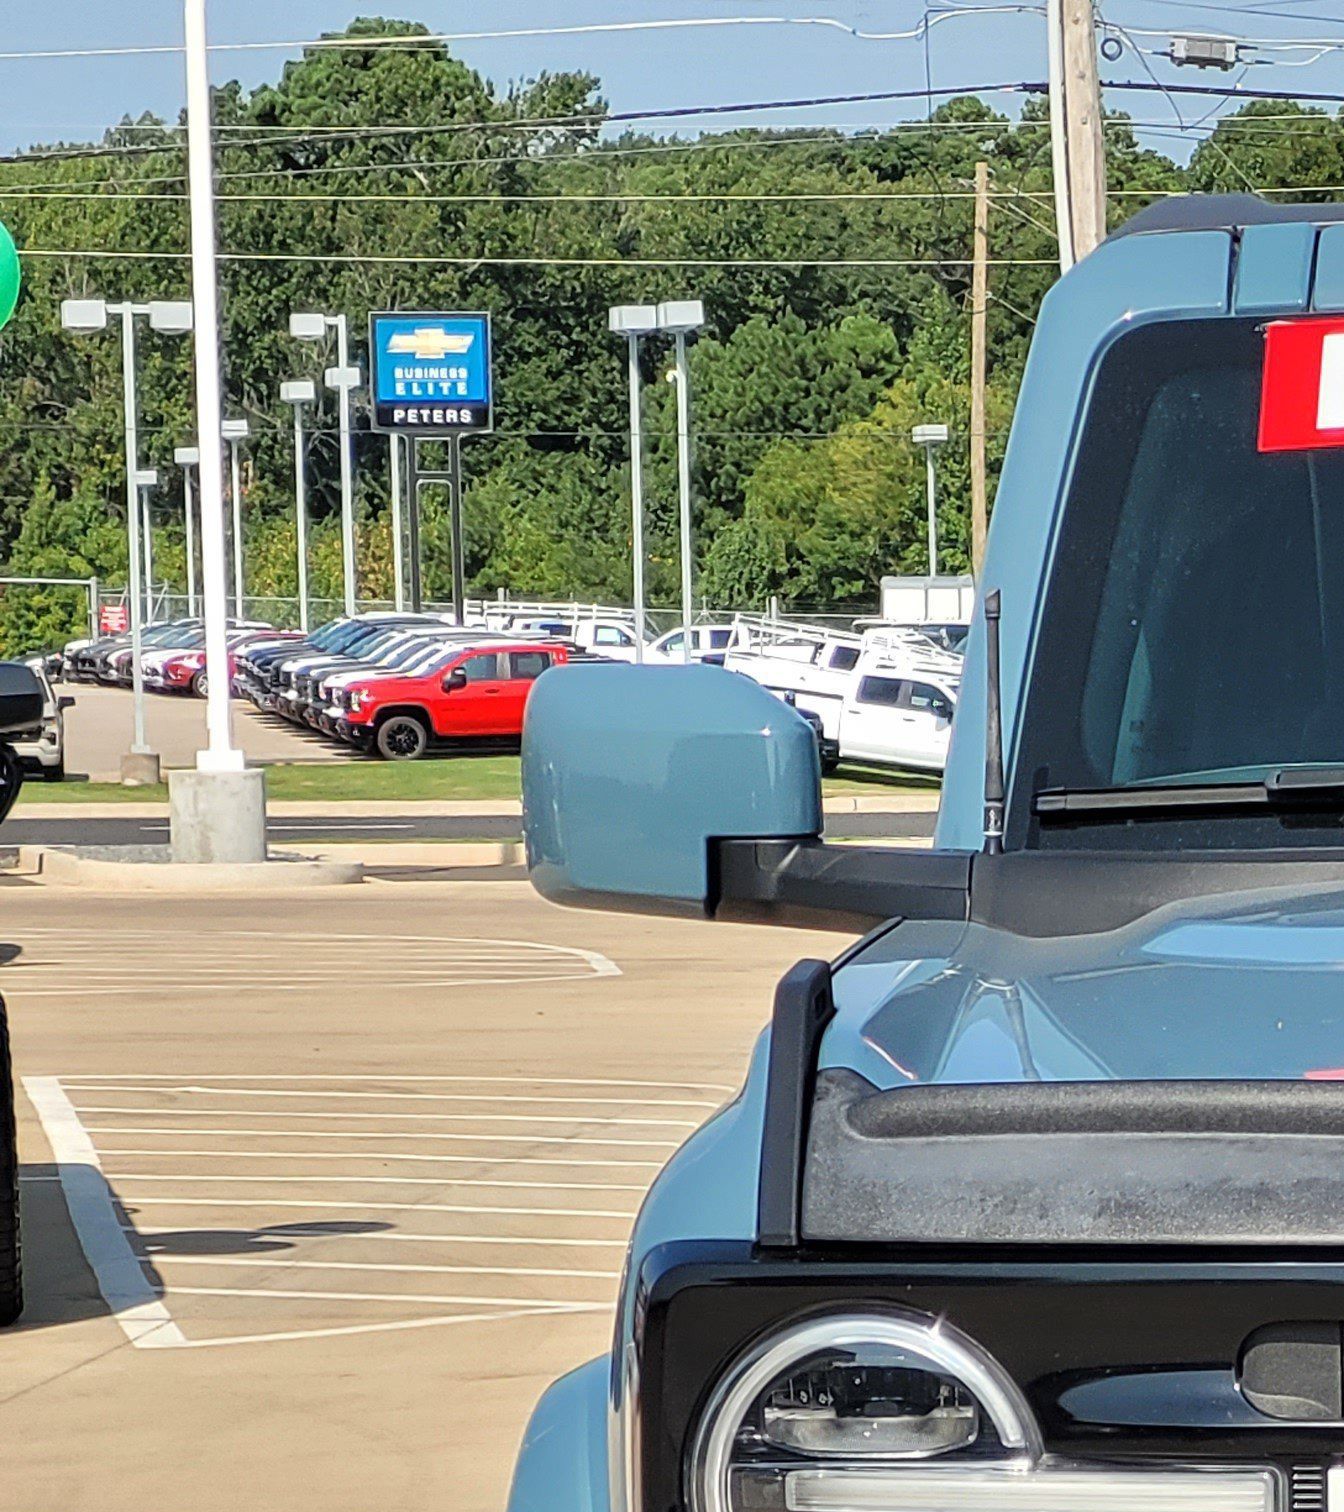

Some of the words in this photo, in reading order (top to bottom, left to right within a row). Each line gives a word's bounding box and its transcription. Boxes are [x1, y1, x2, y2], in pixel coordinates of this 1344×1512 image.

[394, 367, 468, 379] BUSINESS
[395, 382, 468, 396] ELITE
[393, 409, 472, 423] PETERS
